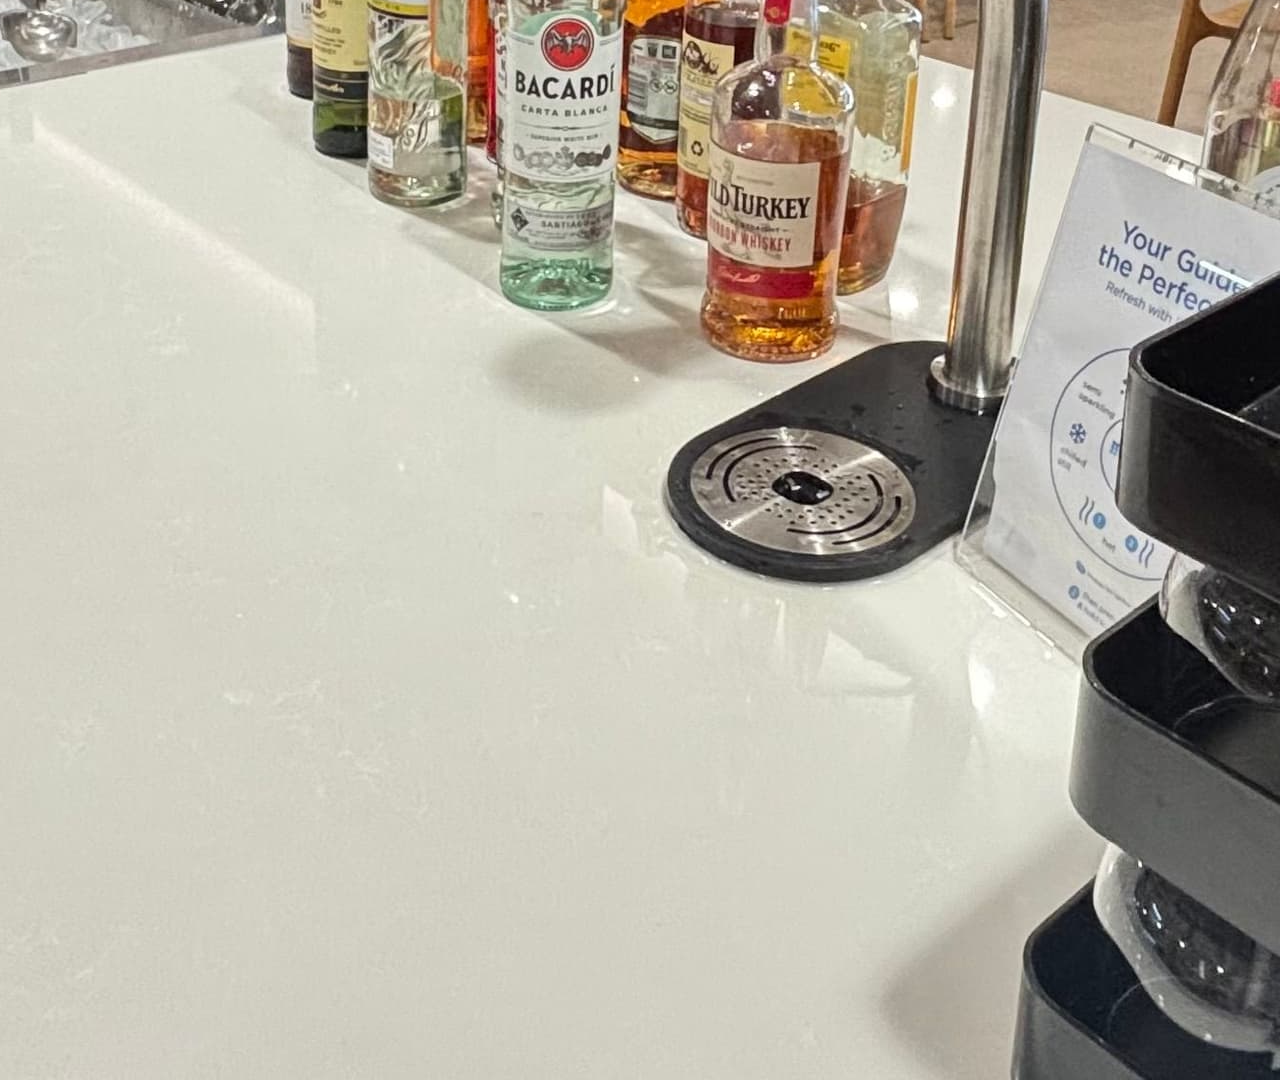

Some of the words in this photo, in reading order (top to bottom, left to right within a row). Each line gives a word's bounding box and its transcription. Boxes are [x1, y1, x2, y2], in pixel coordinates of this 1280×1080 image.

[515, 64, 615, 100] BACARDÍ
[521, 104, 559, 117] CARTA
[564, 105, 608, 117] BLANCA
[710, 177, 730, 207] ILD
[730, 184, 812, 221] TURKEY
[740, 231, 792, 252] WHISKEY
[1122, 219, 1172, 262] Your
[1097, 244, 1133, 278] the
[1138, 263, 1214, 313] Perfec
[1105, 280, 1147, 311] Refresh
[1148, 303, 1173, 323] with
